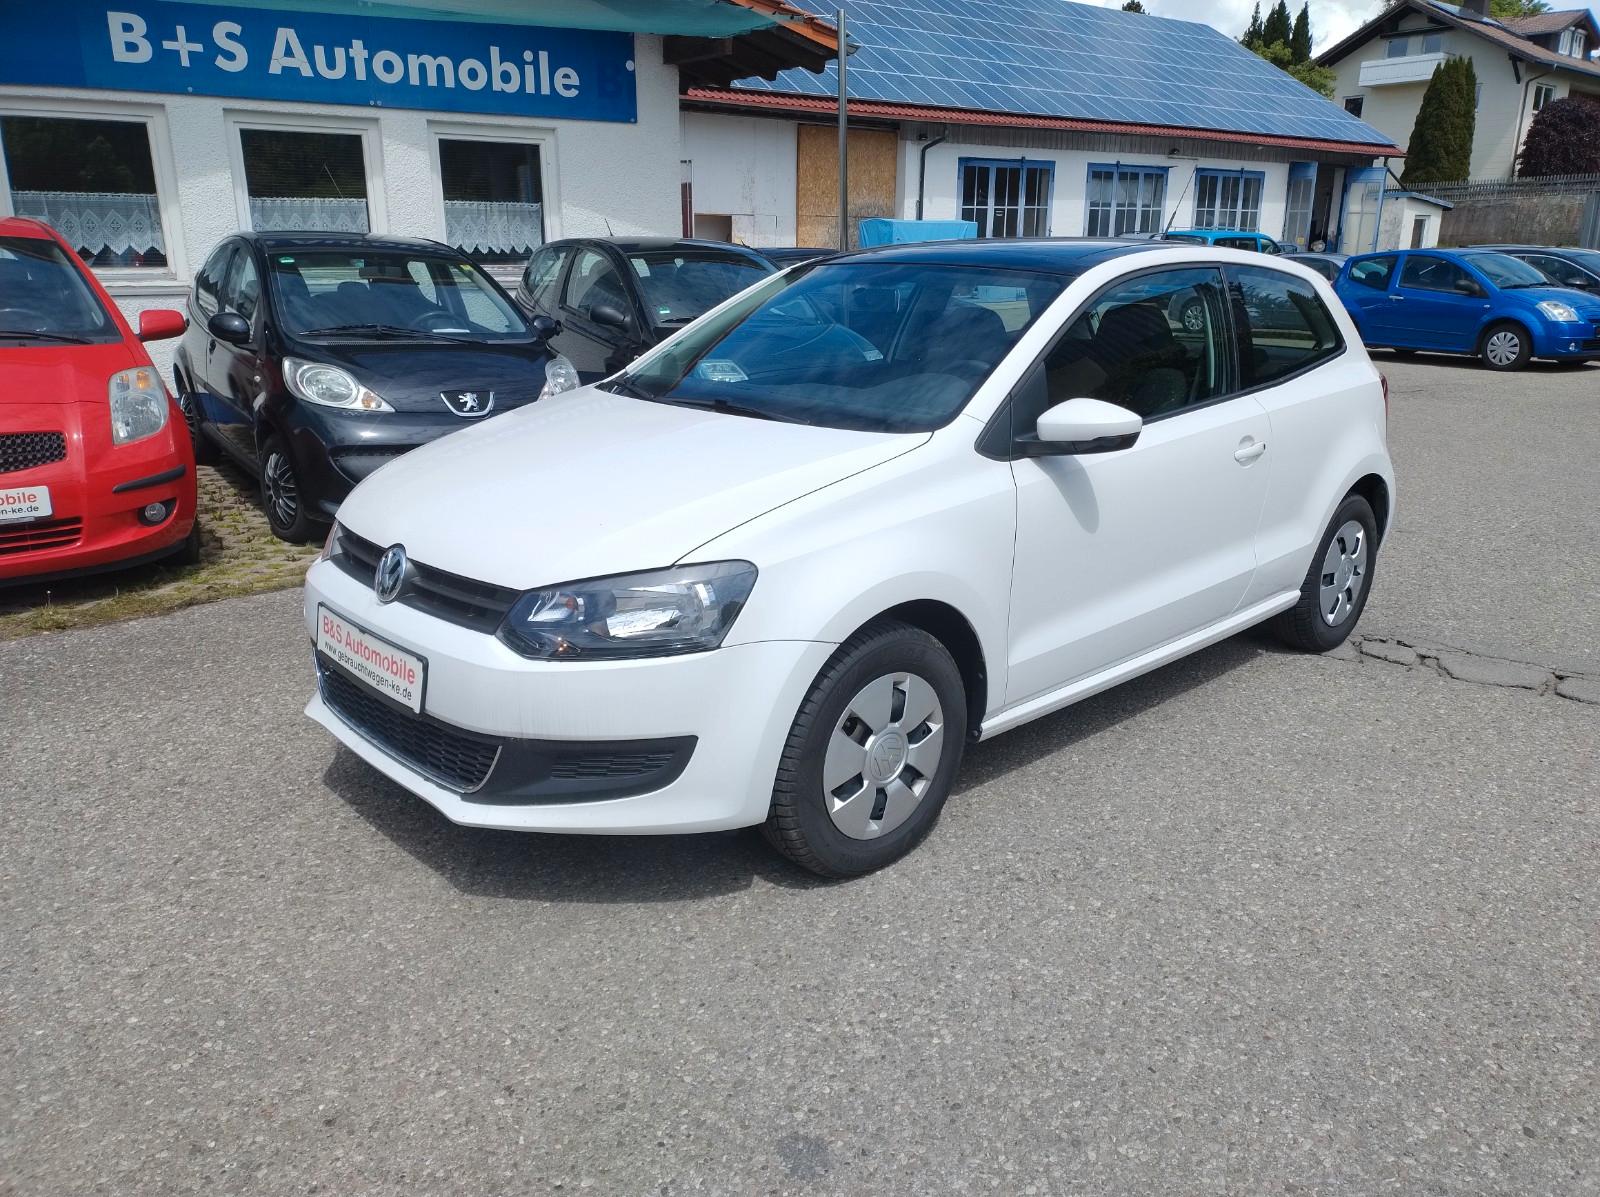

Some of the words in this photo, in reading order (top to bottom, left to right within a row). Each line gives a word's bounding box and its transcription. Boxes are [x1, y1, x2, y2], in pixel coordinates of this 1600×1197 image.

[107, 11, 249, 72] B+S
[268, 27, 581, 98] Automobile
[0, 505, 39, 515] n-ke.de
[323, 614, 343, 644] B&S
[345, 631, 415, 684] Automobile
[325, 641, 412, 701] www.gebrauchtwagen-ke.de
